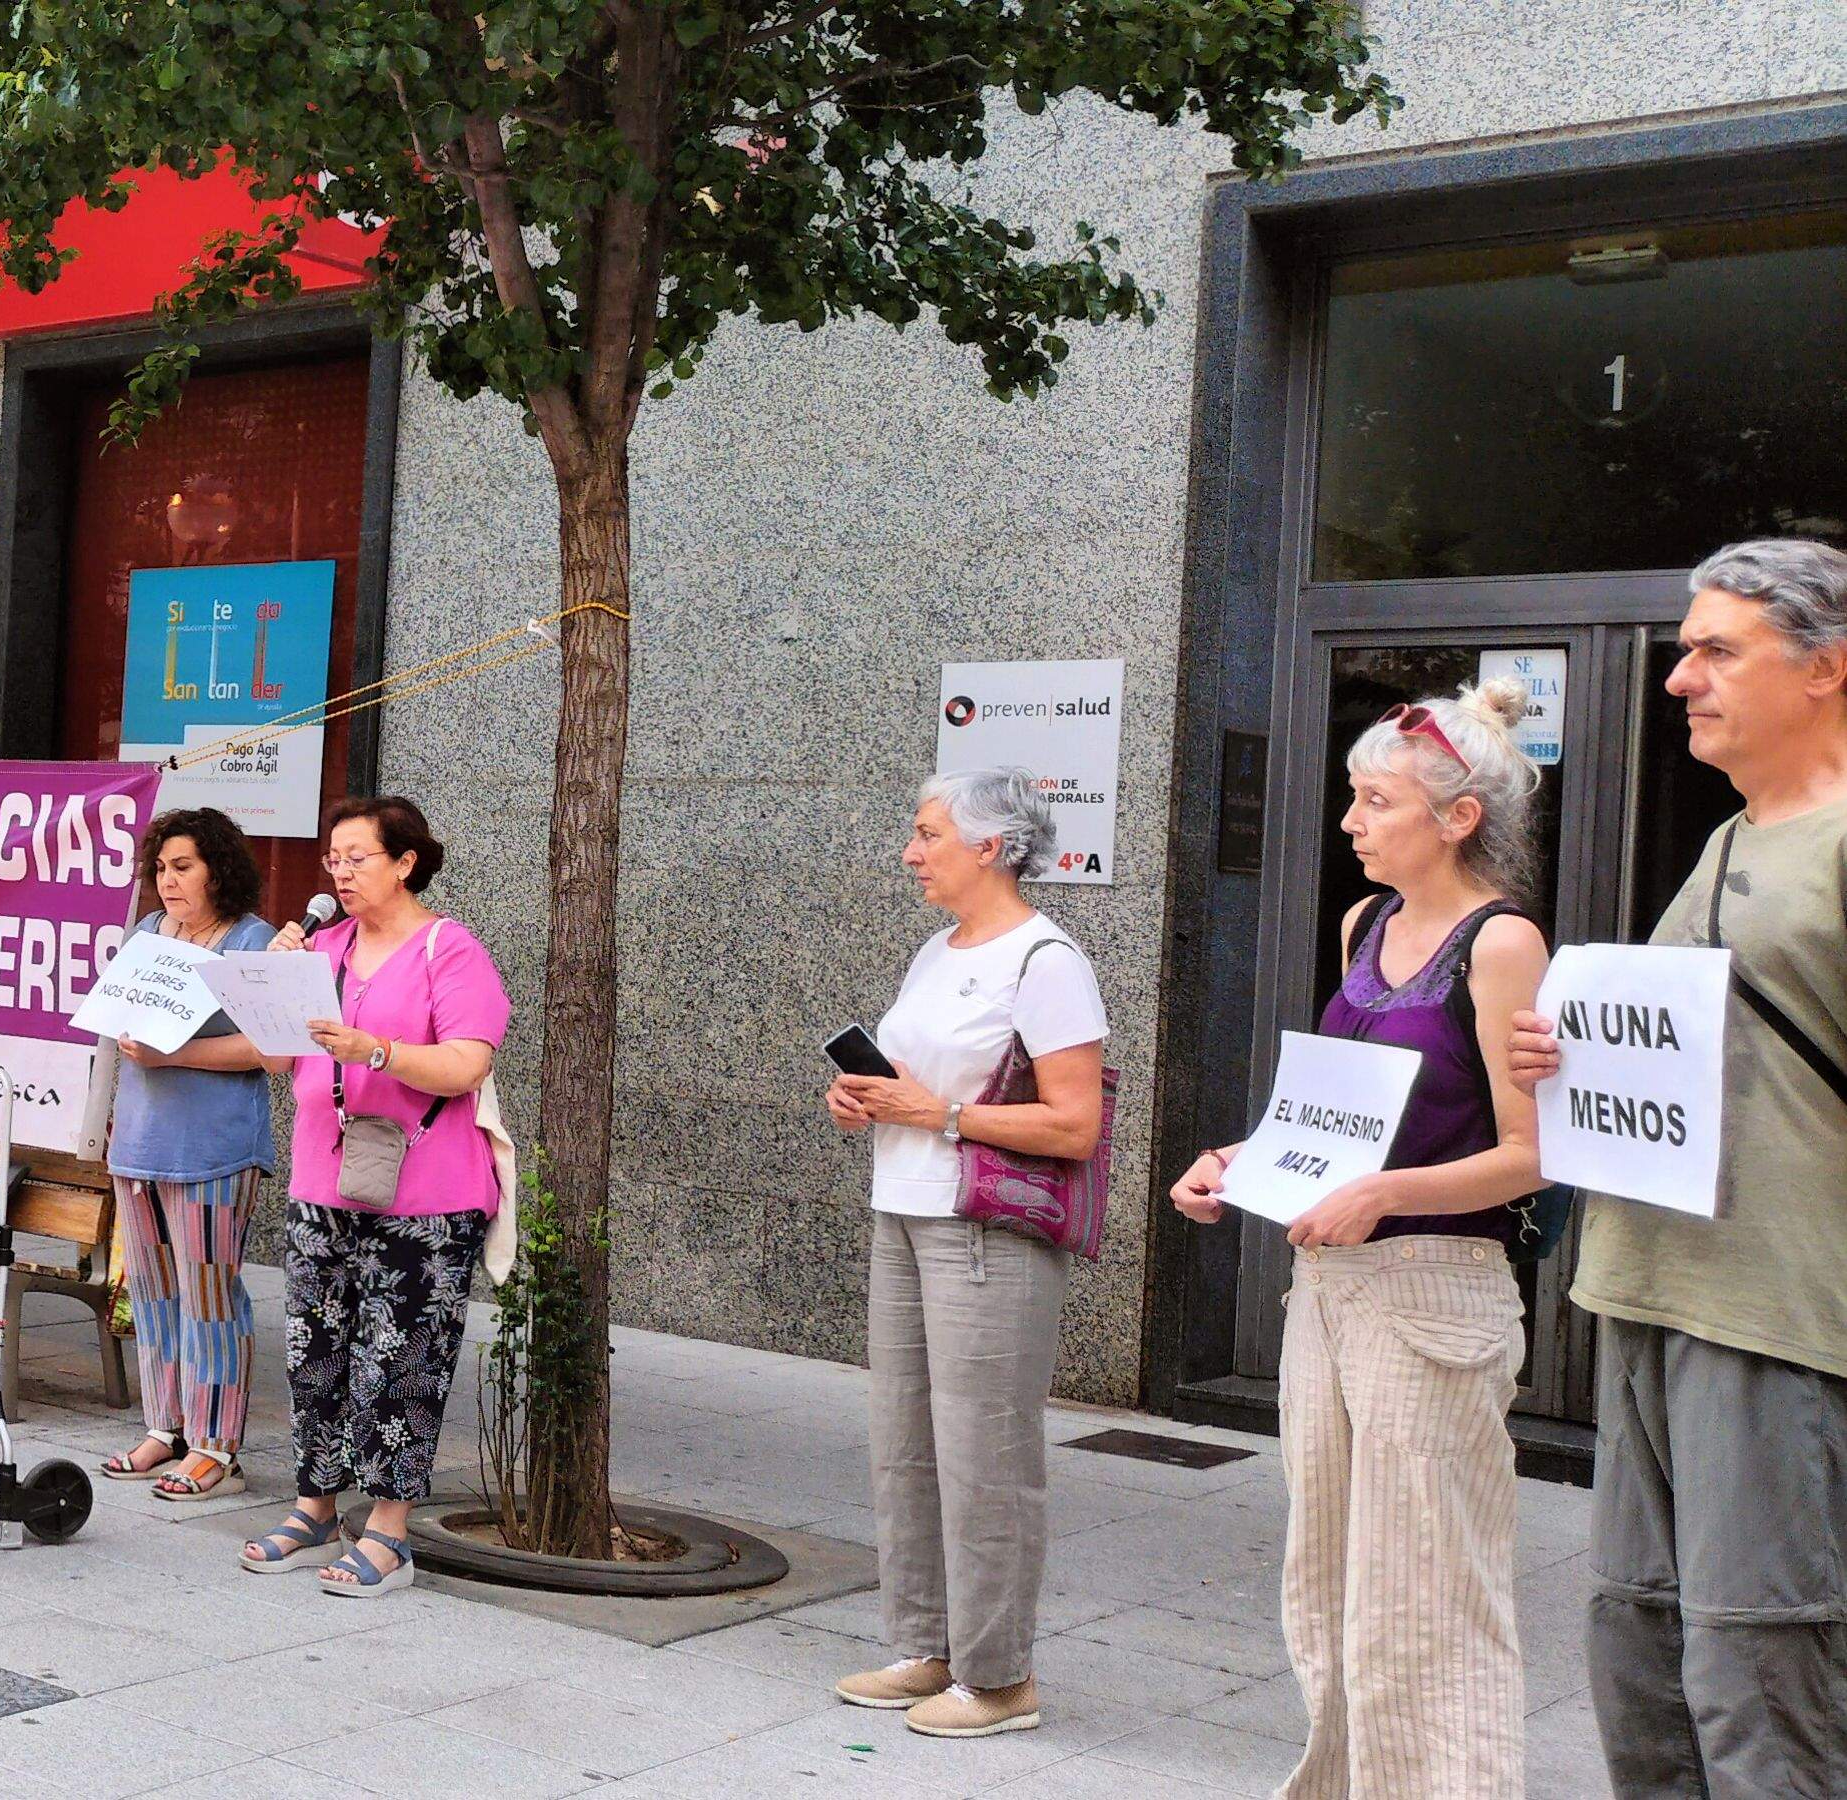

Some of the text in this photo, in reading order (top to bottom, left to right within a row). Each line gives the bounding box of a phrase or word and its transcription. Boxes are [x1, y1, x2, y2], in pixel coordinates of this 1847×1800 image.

[1603, 354, 1625, 412] 1
[167, 600, 185, 622] Si
[213, 598, 234, 621] te
[1514, 655, 1534, 674] SE
[162, 679, 199, 701] San
[208, 680, 240, 700] tan
[981, 696, 1111, 722] preven salud
[220, 758, 253, 773] Cobro
[255, 756, 278, 776] Ágil
[1061, 778, 1079, 790] DE
[154, 953, 194, 973] VIVAS
[99, 983, 125, 998] NOS
[131, 967, 187, 992] Y LIBRES
[1557, 999, 1681, 1051] NI UNA
[1274, 1098, 1385, 1143] EL MACHISMO
[1569, 1086, 1687, 1147] MENOS
[1274, 1150, 1330, 1179] MATA
